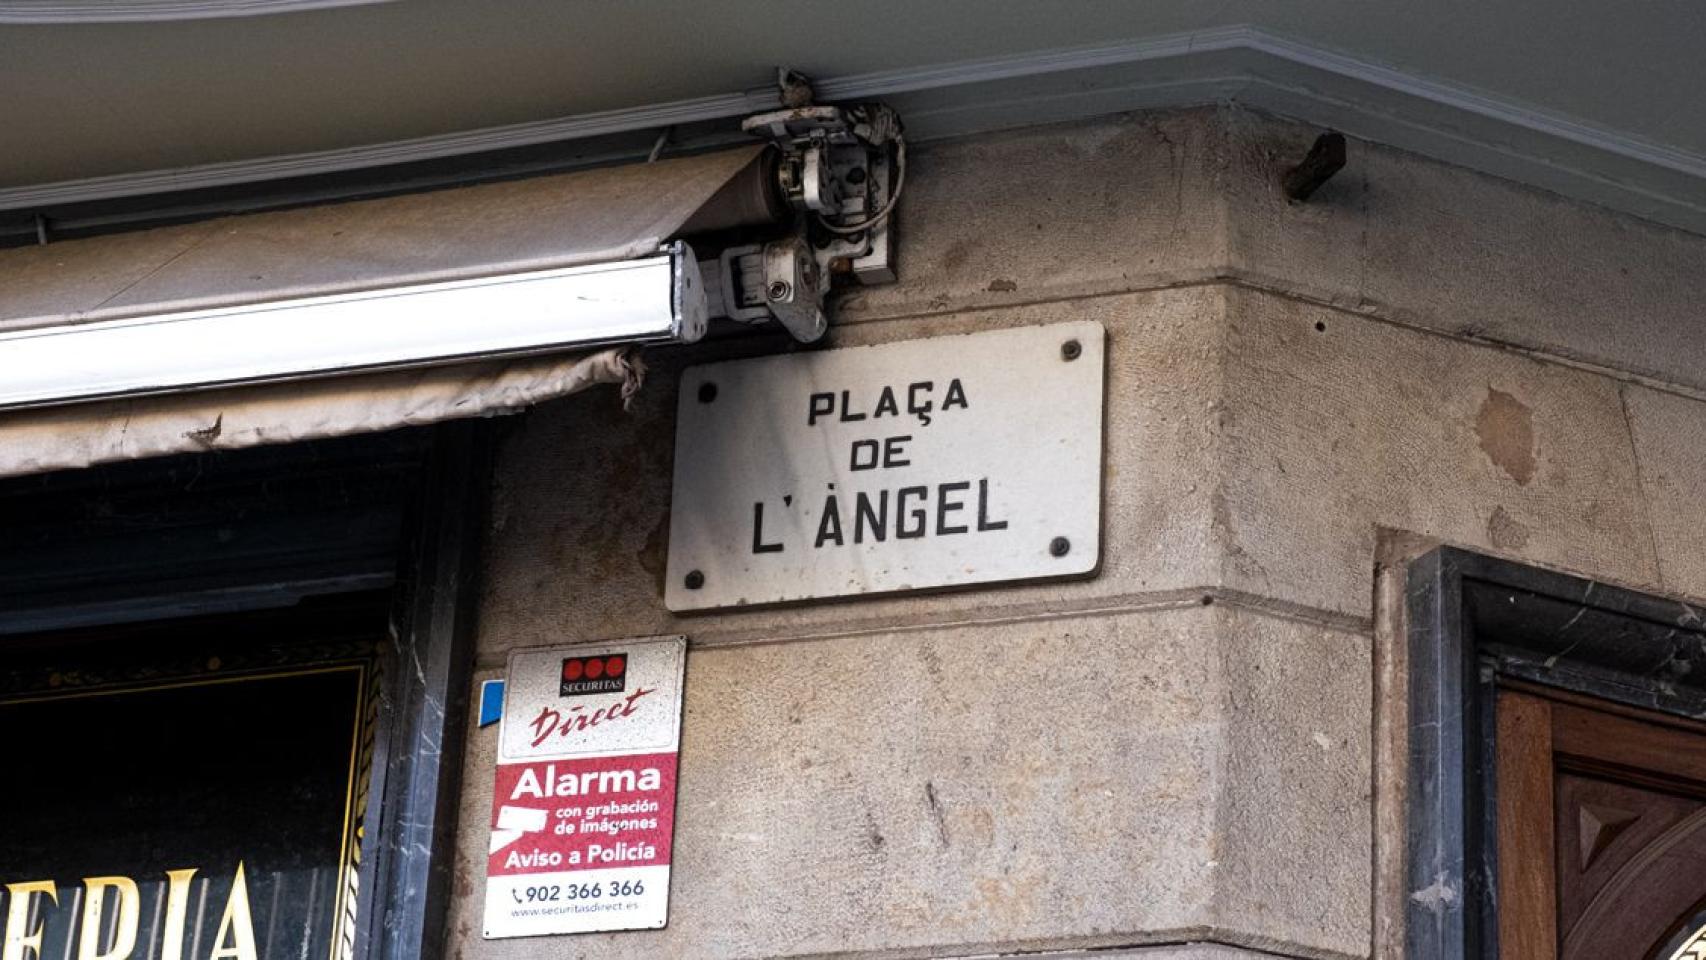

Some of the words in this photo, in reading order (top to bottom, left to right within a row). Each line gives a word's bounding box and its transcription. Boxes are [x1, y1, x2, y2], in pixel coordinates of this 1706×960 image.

[808, 378, 968, 426] PLAÇA
[850, 435, 912, 471] DE
[562, 680, 623, 693] SECURITAS
[530, 688, 656, 748] Direct
[510, 764, 661, 800] Alarma
[555, 806, 582, 818] con
[585, 799, 658, 820] grabación
[554, 821, 576, 835] de
[580, 817, 658, 836] imágenes
[504, 848, 562, 869] Aviso
[569, 851, 581, 864] a
[587, 841, 656, 864] Policía
[526, 885, 561, 903] 902
[567, 882, 602, 900] 366
[609, 879, 644, 897] 366
[511, 901, 639, 917] www.securitasdirect.es
